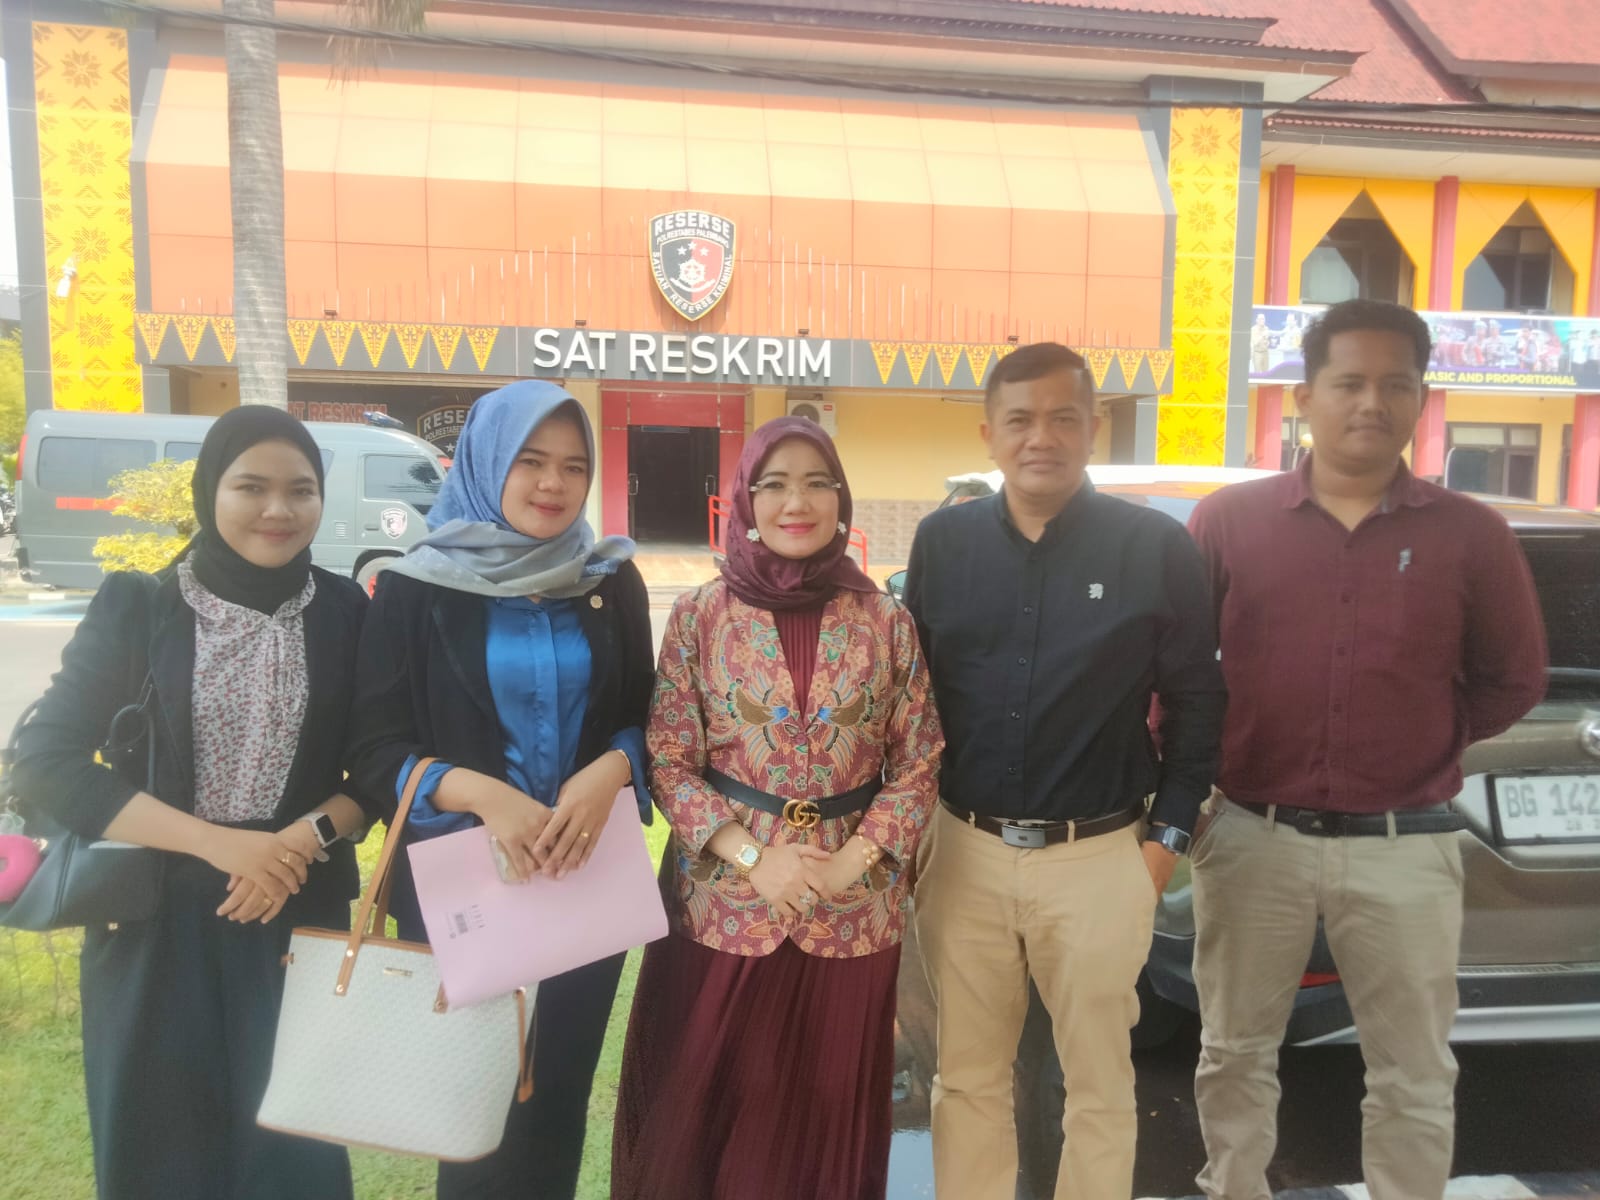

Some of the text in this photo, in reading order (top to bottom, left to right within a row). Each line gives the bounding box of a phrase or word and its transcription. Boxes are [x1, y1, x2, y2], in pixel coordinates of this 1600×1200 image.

[654, 212, 730, 239] RESERSE
[652, 251, 733, 314] SATUAN RESERSE KRIMINAL
[532, 328, 832, 379] SAT RESKRIM
[1457, 372, 1484, 383] AND
[1485, 373, 1577, 386] PROPORTIONAL
[423, 409, 470, 434] RESE
[1504, 784, 1539, 818] BG
